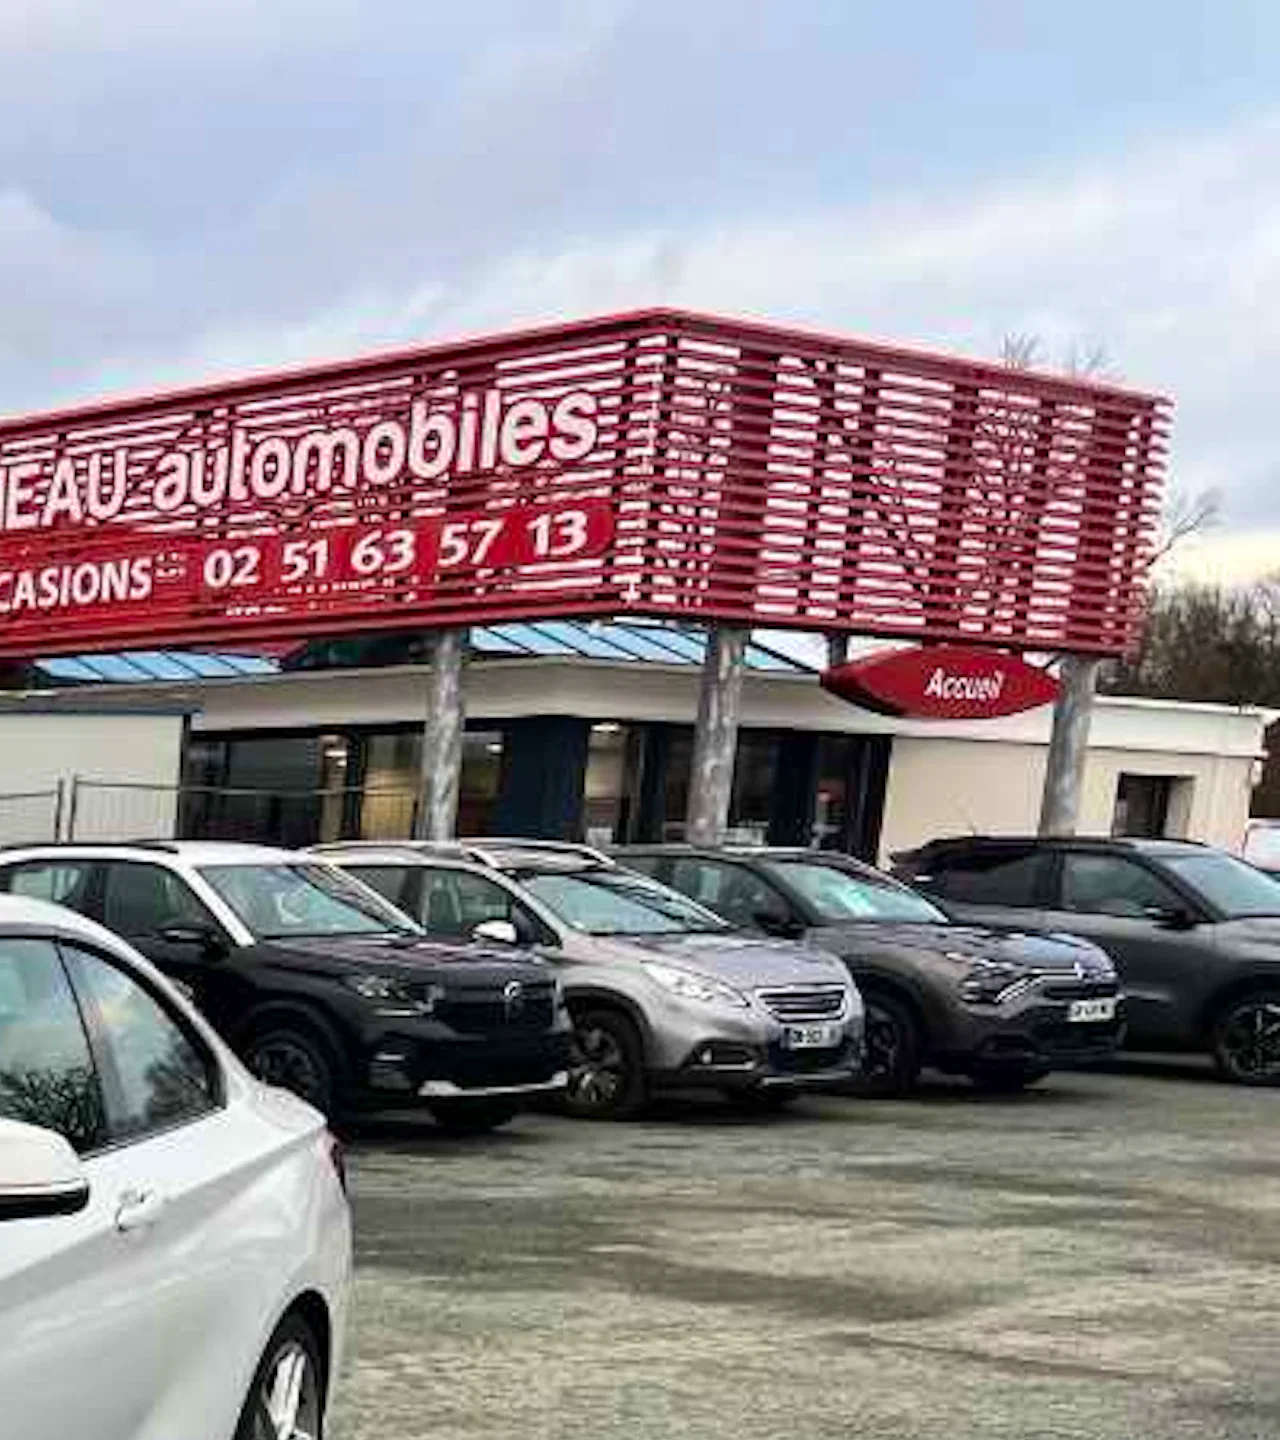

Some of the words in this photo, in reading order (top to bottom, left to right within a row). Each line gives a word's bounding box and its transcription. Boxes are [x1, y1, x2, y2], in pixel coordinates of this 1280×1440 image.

[153, 390, 598, 510] automobiles
[202, 546, 261, 588] 02
[281, 539, 329, 581] 51
[350, 530, 416, 573] 63
[438, 519, 504, 567] 57
[527, 509, 588, 557] 13
[923, 667, 1005, 700] Accueil
